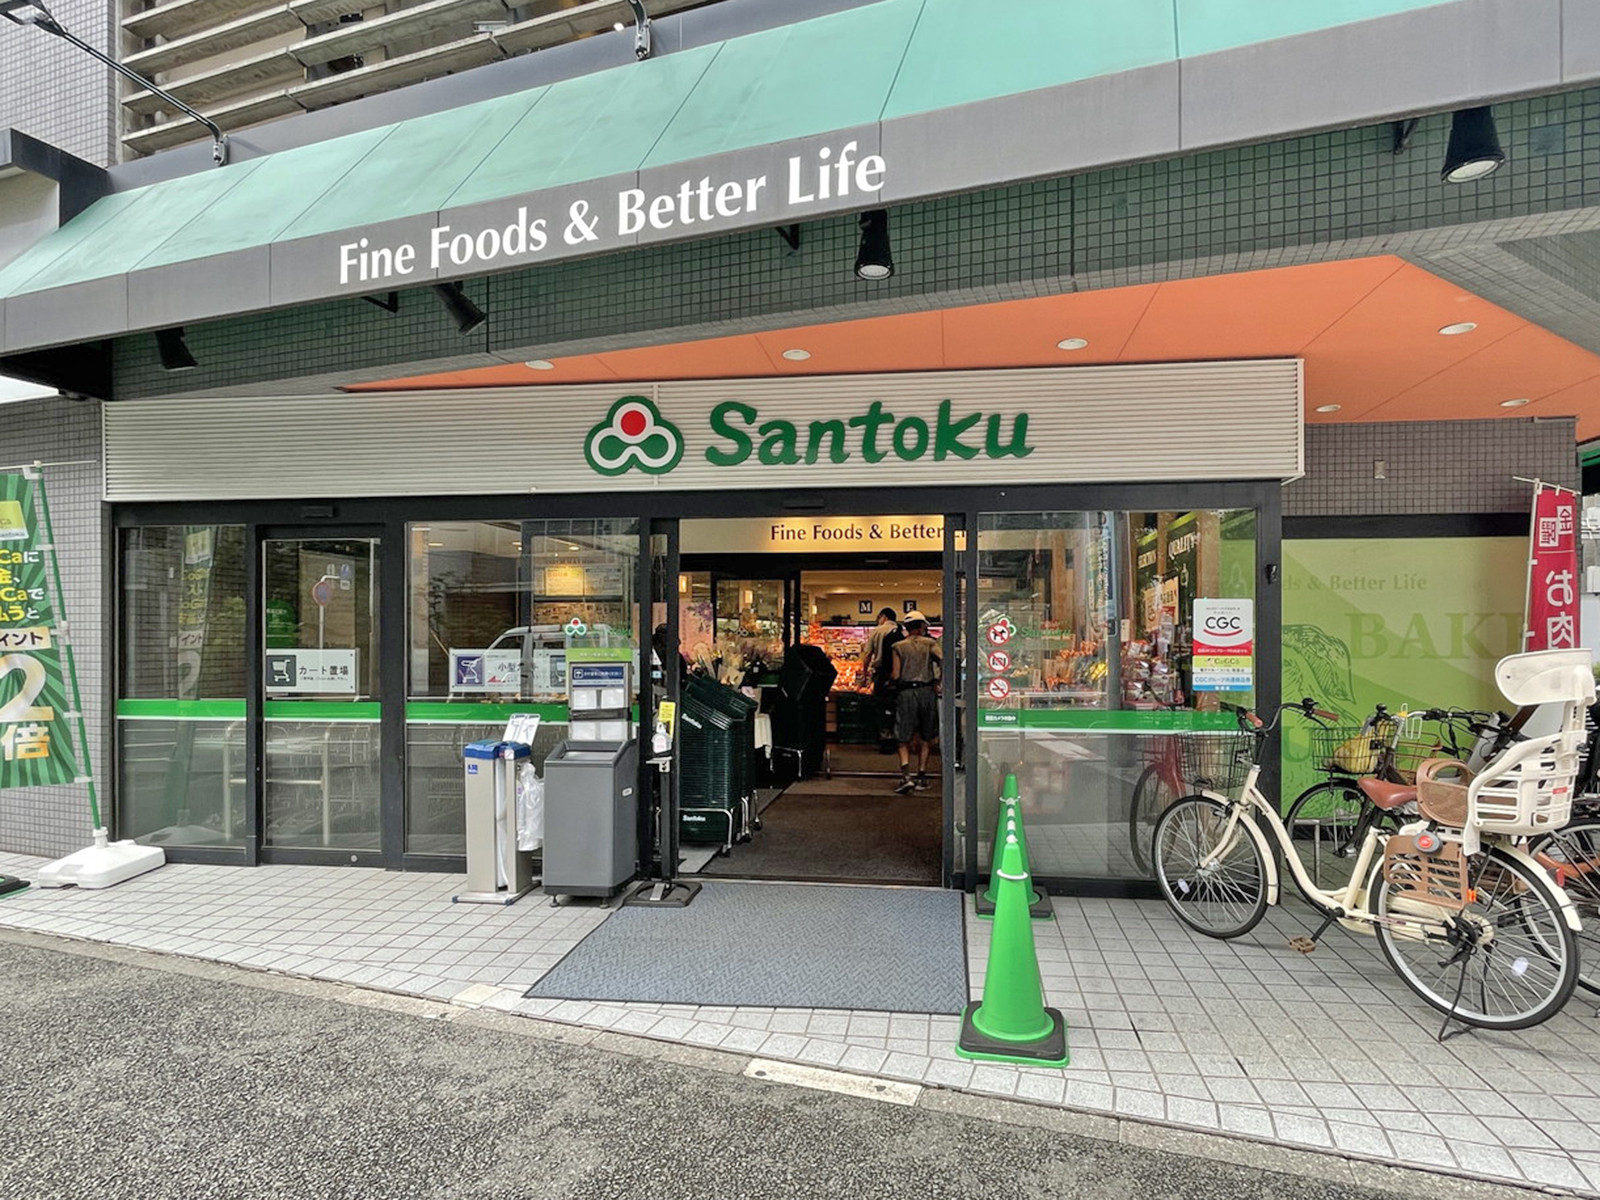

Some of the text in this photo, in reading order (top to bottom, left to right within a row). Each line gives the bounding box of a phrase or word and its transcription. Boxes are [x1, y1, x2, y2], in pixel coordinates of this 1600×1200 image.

[340, 141, 886, 284] Fine Foods & Better Life
[705, 399, 1035, 466] Santoku
[771, 524, 806, 540] Fine
[813, 523, 863, 540] Foods
[869, 523, 882, 539] &
[890, 523, 944, 539] Better
[1307, 575, 1322, 590] &
[1329, 575, 1386, 590] Better
[1393, 573, 1428, 590] Life
[1205, 616, 1240, 629] CGC
[299, 665, 348, 676] カート置場
[0, 723, 50, 761] 倍
